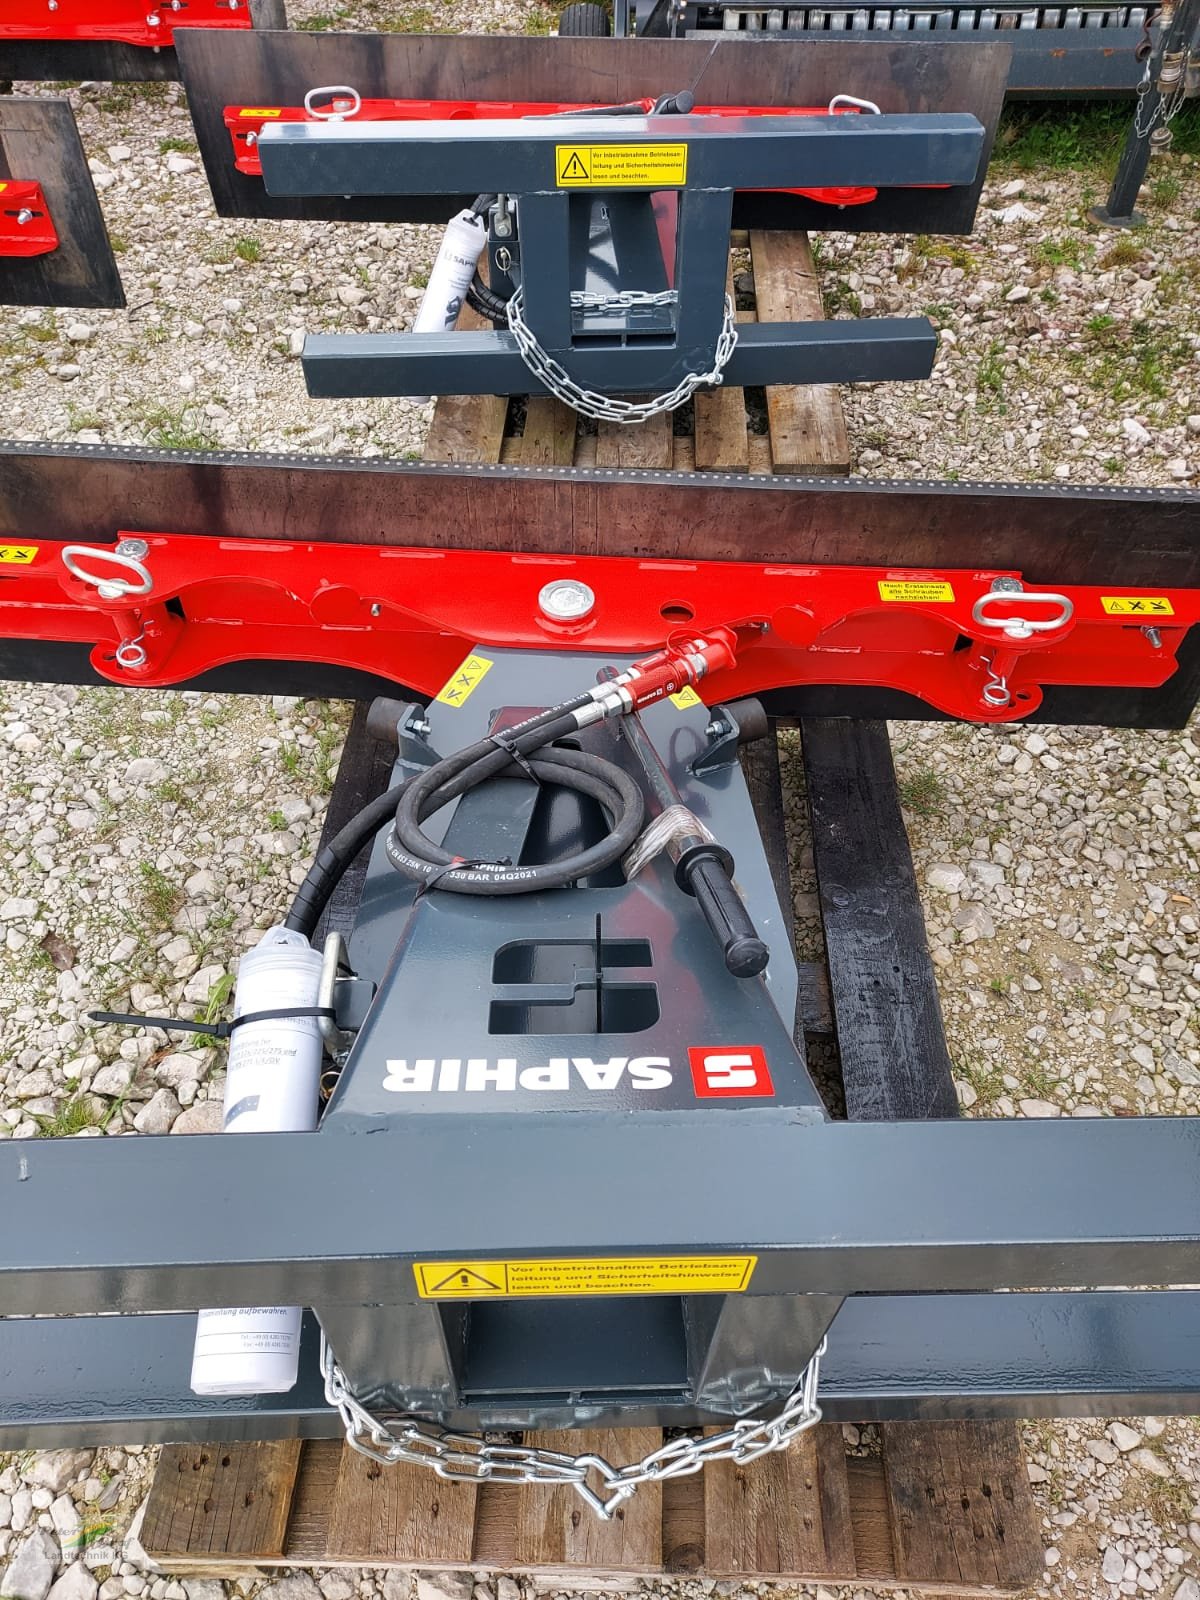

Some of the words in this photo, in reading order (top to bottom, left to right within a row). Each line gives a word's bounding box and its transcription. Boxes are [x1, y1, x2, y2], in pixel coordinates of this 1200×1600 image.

[449, 870, 466, 880] 330
[467, 873, 490, 881] BAR
[494, 869, 537, 881] 04Q2021
[382, 1056, 673, 1093] SAPHIR
[539, 1264, 655, 1272] Inbetriebnahme
[597, 1272, 741, 1280] Sicherheitshinweise
